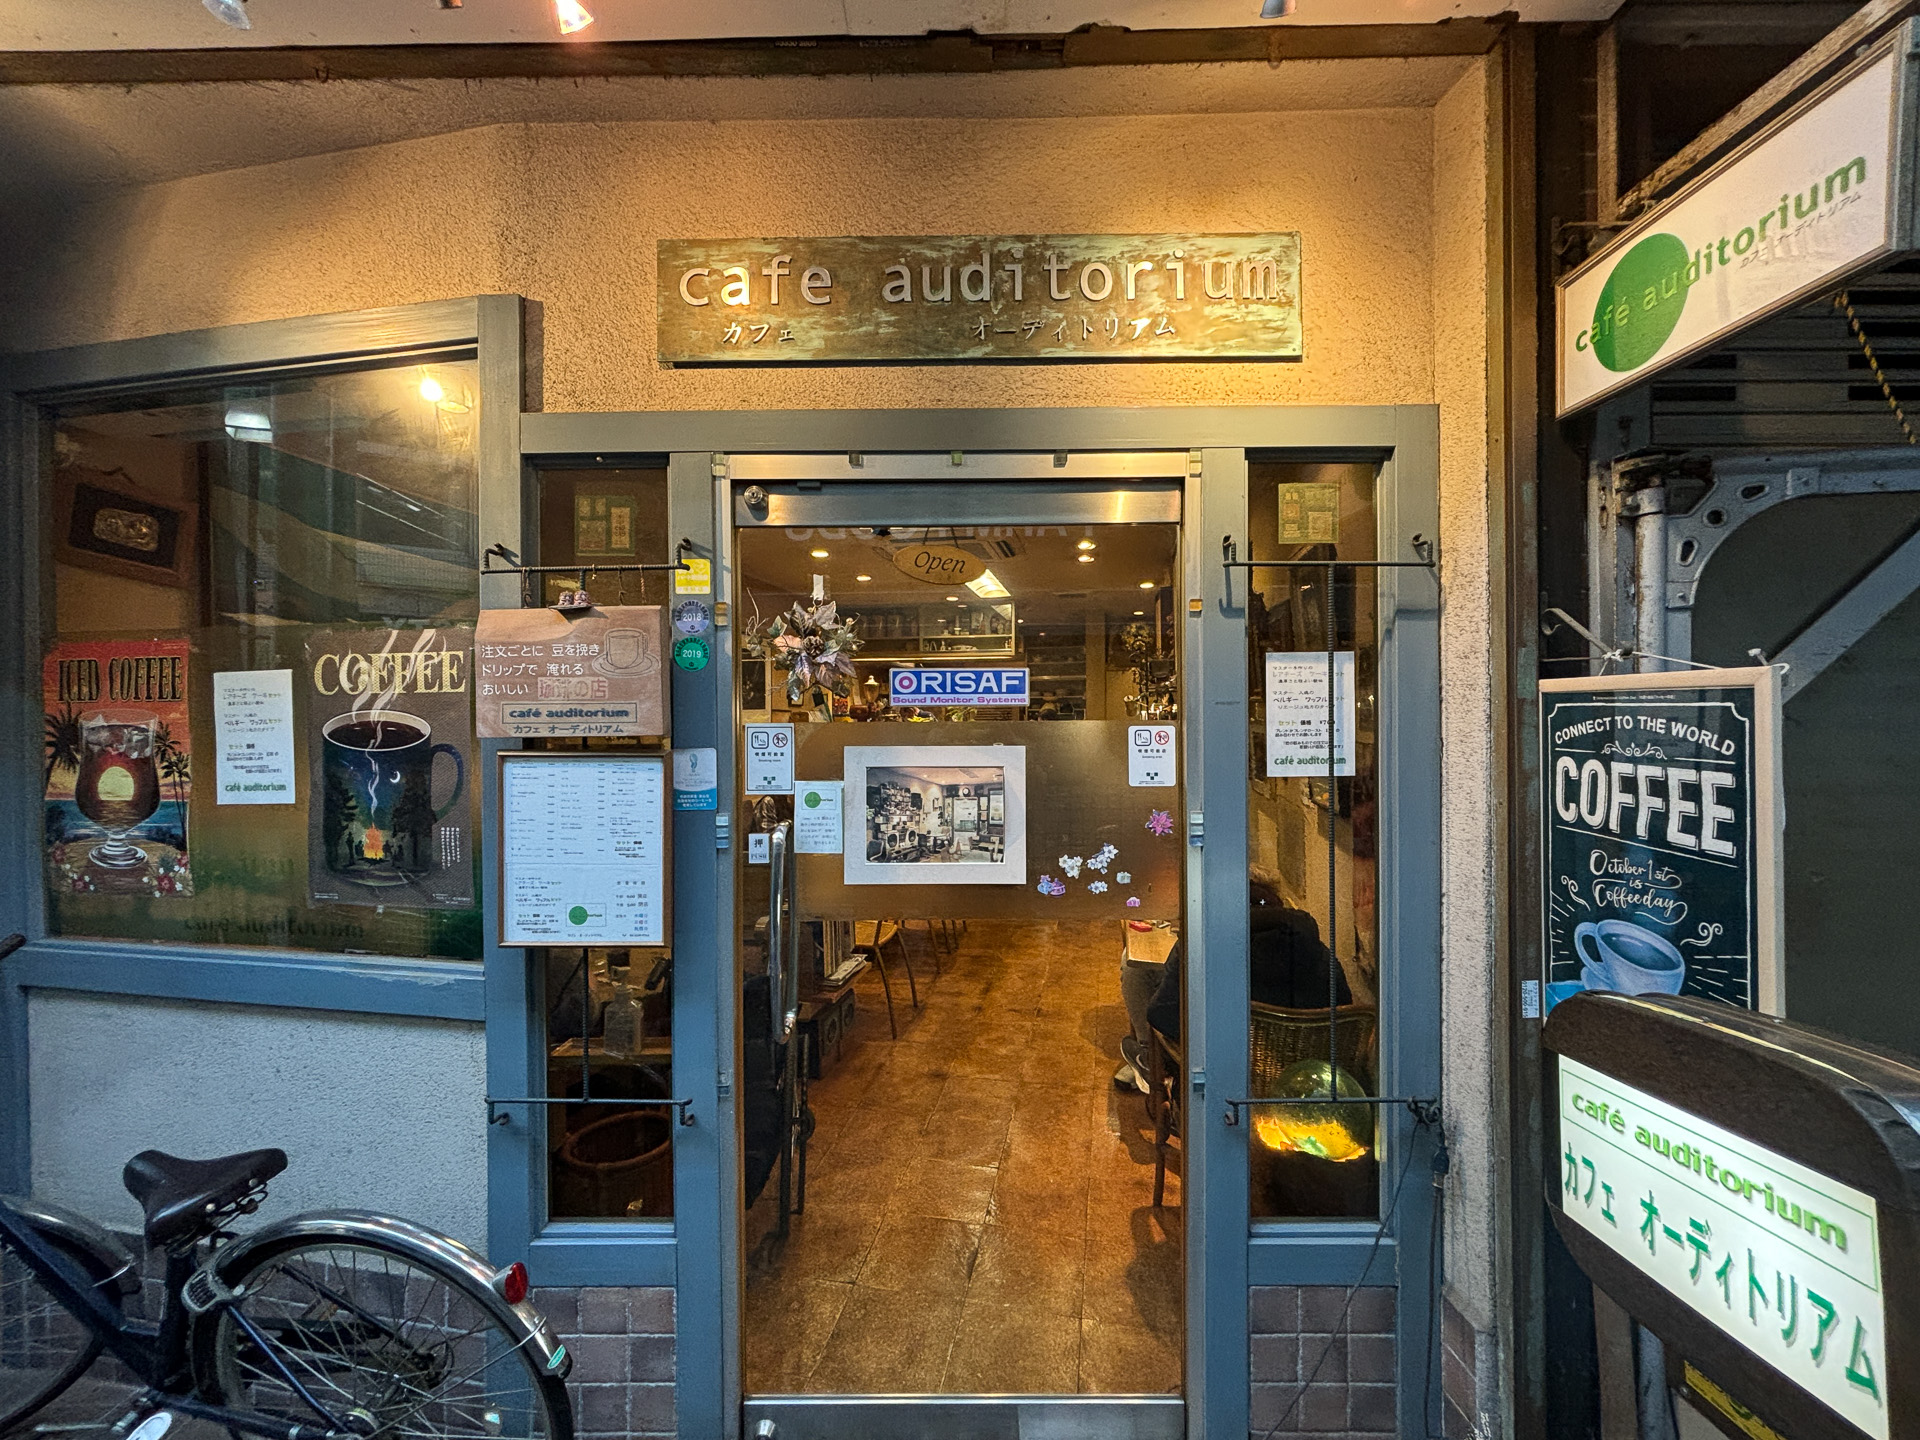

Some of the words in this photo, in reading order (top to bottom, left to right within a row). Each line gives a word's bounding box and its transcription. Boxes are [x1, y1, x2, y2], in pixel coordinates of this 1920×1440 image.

[1575, 297, 1631, 353] café
[1642, 156, 1867, 311] auditorium
[679, 254, 833, 306] cafe
[882, 247, 1280, 304] auditorium
[721, 321, 796, 345] カフェ
[970, 315, 1177, 341] オーディトリアム
[915, 550, 966, 574] Open
[683, 612, 702, 621] 2018
[481, 645, 544, 658] 注文ごとに
[551, 643, 600, 657] 豆を挽き
[682, 650, 702, 659] 2019
[58, 658, 99, 702] ICED
[109, 656, 183, 702] COFFEE
[314, 650, 466, 695] COFFEE
[481, 663, 538, 677] ドリップで
[546, 663, 584, 676] 淹れる
[482, 684, 529, 696] おいしい
[894, 672, 1024, 694] ORISAF
[892, 696, 927, 704] Sound
[930, 696, 974, 704] Monitor
[977, 696, 1026, 705] Systems
[509, 708, 541, 718] café
[545, 707, 630, 718] auditorium
[513, 725, 540, 734] カフェ
[548, 724, 624, 734] オーディトリアム
[1555, 715, 1612, 745] CONNECT
[1615, 715, 1634, 730] TO
[1637, 715, 1667, 735] THE
[1671, 721, 1736, 756] WORLD
[1274, 755, 1295, 765] café
[1555, 755, 1737, 859] COFFEE
[1589, 849, 1646, 876] October
[1629, 877, 1643, 889] is
[1571, 1091, 1627, 1134] café
[1634, 1124, 1848, 1252] auditorium
[1563, 1141, 1618, 1228] カフェ
[1639, 1189, 1882, 1408] オーディトリアム
